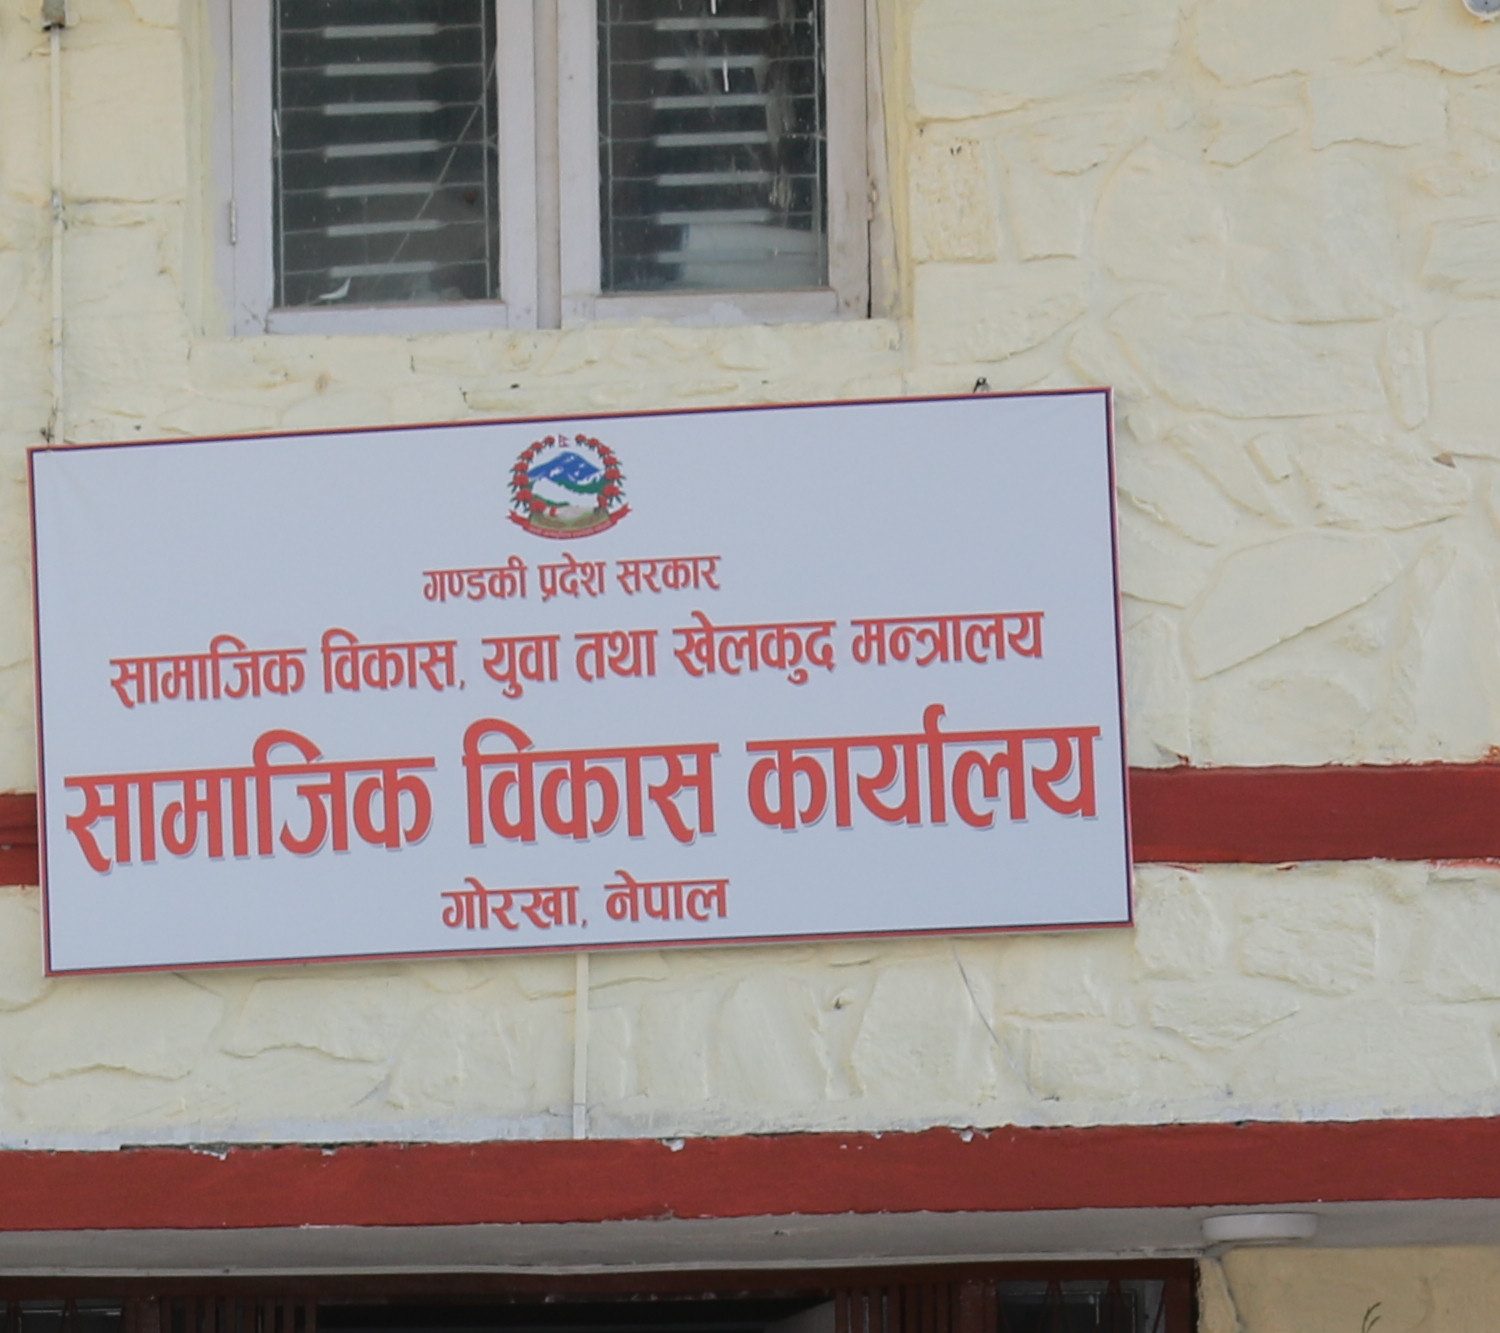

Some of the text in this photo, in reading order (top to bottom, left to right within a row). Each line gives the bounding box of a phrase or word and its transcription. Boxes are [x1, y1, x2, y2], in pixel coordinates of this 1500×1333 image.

[423, 552, 720, 602] गण्डकी प्रदेश सरकार
[110, 609, 1045, 709] सामाजिक विकास, युवा तथा खेलकुद मन्त्रालय
[64, 703, 1101, 874] सामाजिक विकास कार्यालय
[441, 869, 729, 932] गोरखा, नेपाल
